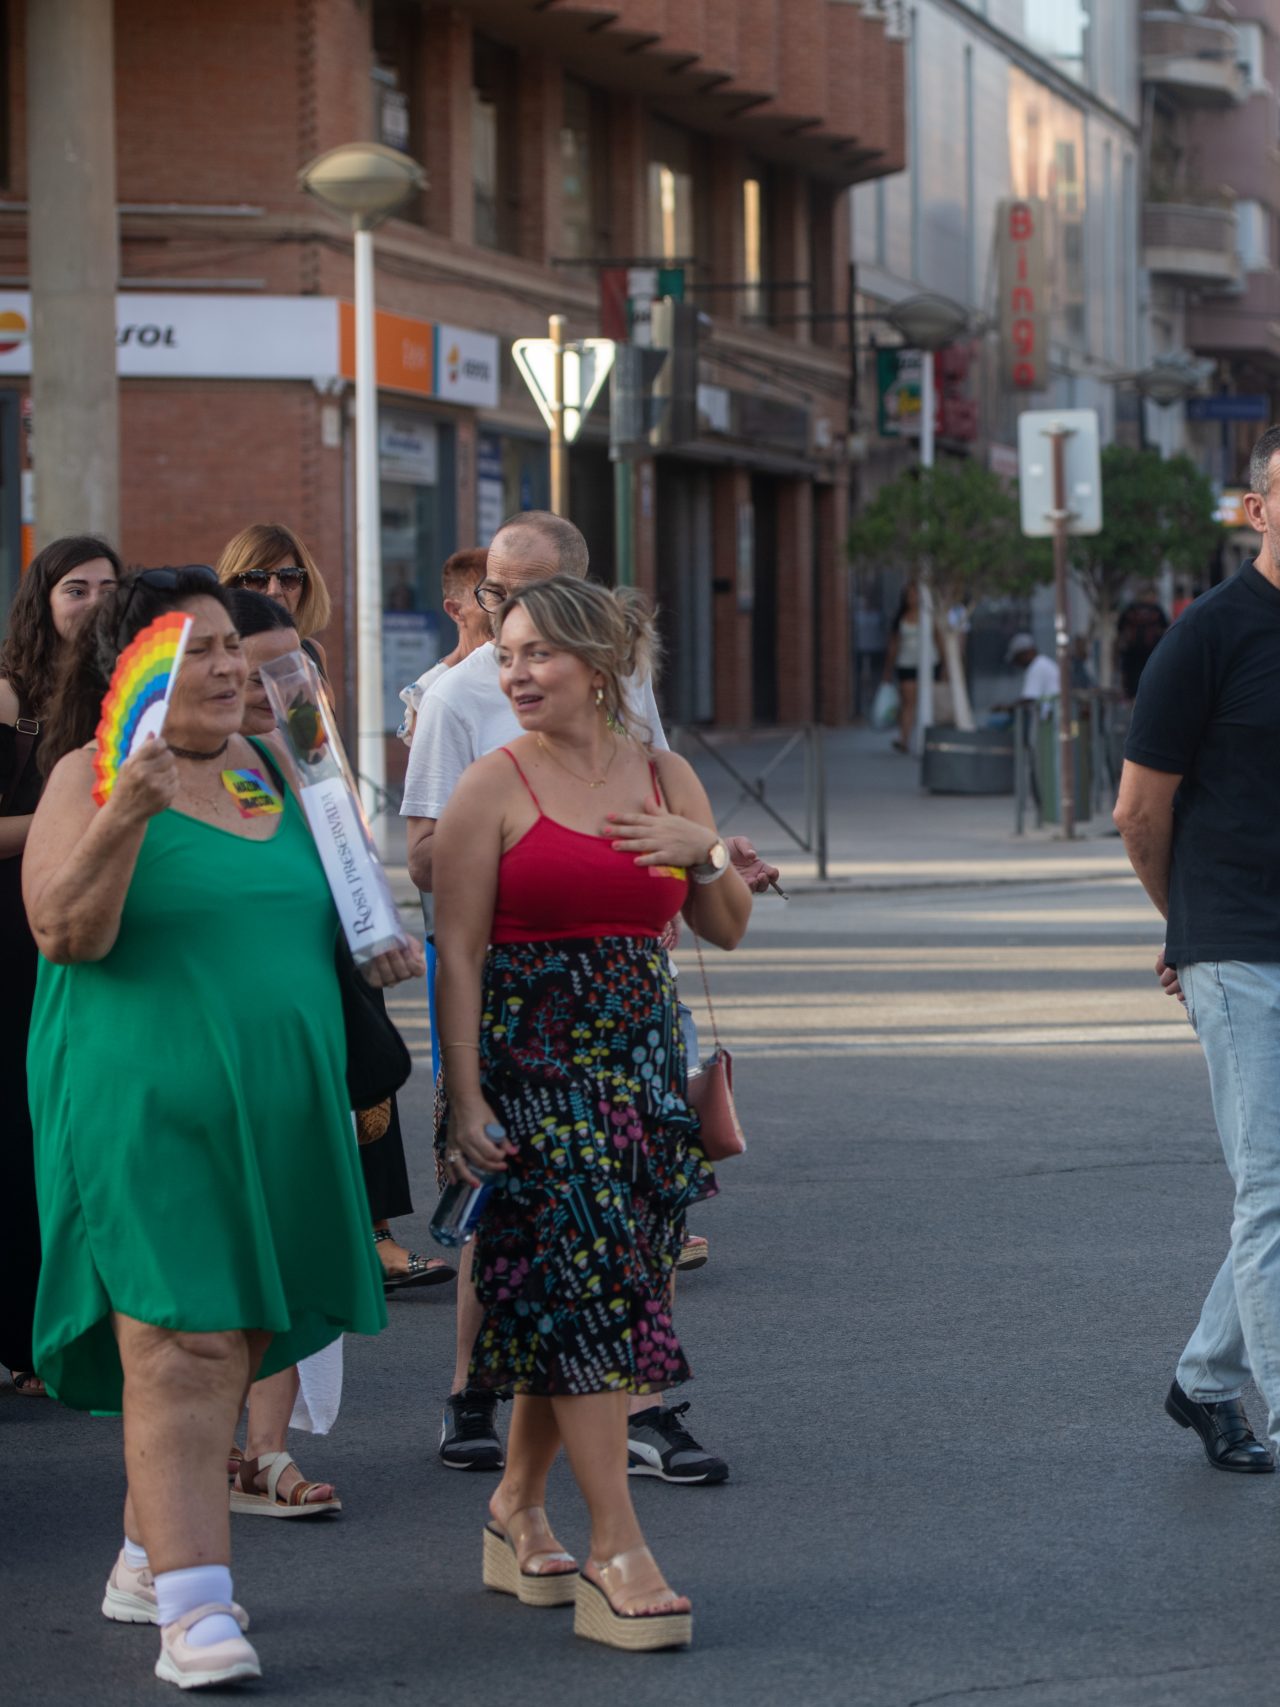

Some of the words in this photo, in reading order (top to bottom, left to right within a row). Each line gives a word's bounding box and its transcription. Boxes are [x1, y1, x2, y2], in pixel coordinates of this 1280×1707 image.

[116, 323, 178, 348] SOL
[1009, 201, 1036, 387] Bingo
[321, 791, 361, 884] PRESERVADA
